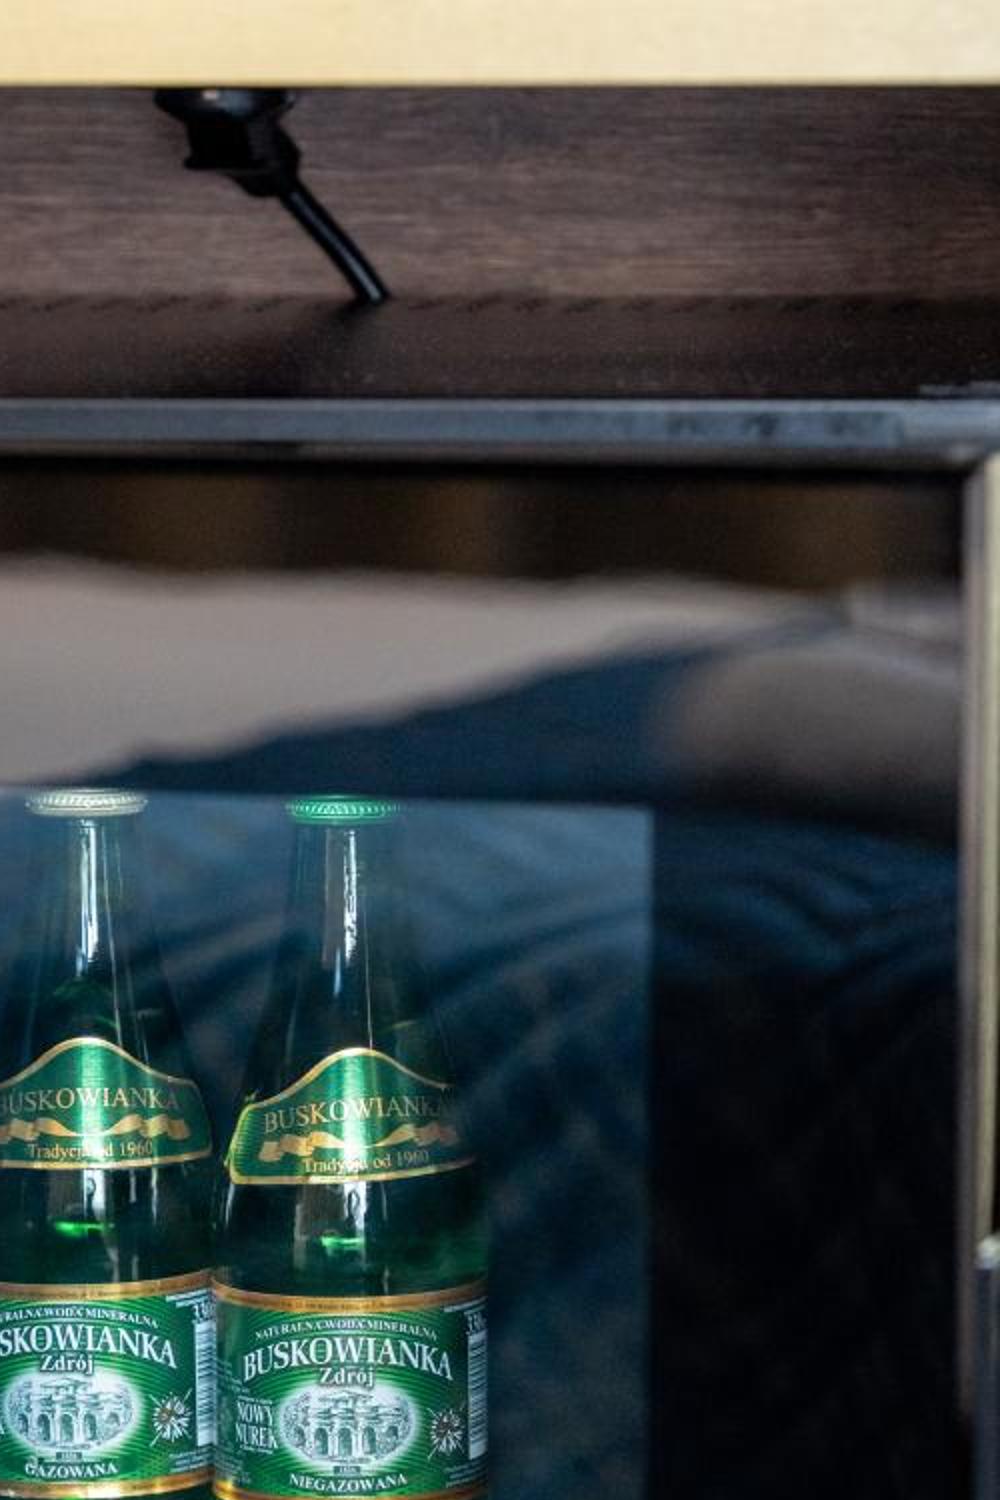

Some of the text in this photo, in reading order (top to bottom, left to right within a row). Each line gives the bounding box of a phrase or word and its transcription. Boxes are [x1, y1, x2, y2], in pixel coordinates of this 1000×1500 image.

[264, 1095, 448, 1133] BUSKOWIANK
[40, 1353, 94, 1375] Zdrój
[243, 1336, 454, 1382] BUSKOWIANKA
[319, 1367, 375, 1387] Zdrój
[25, 1461, 119, 1479] GAZOWANA
[289, 1473, 408, 1492] NIEGAZOWANA
